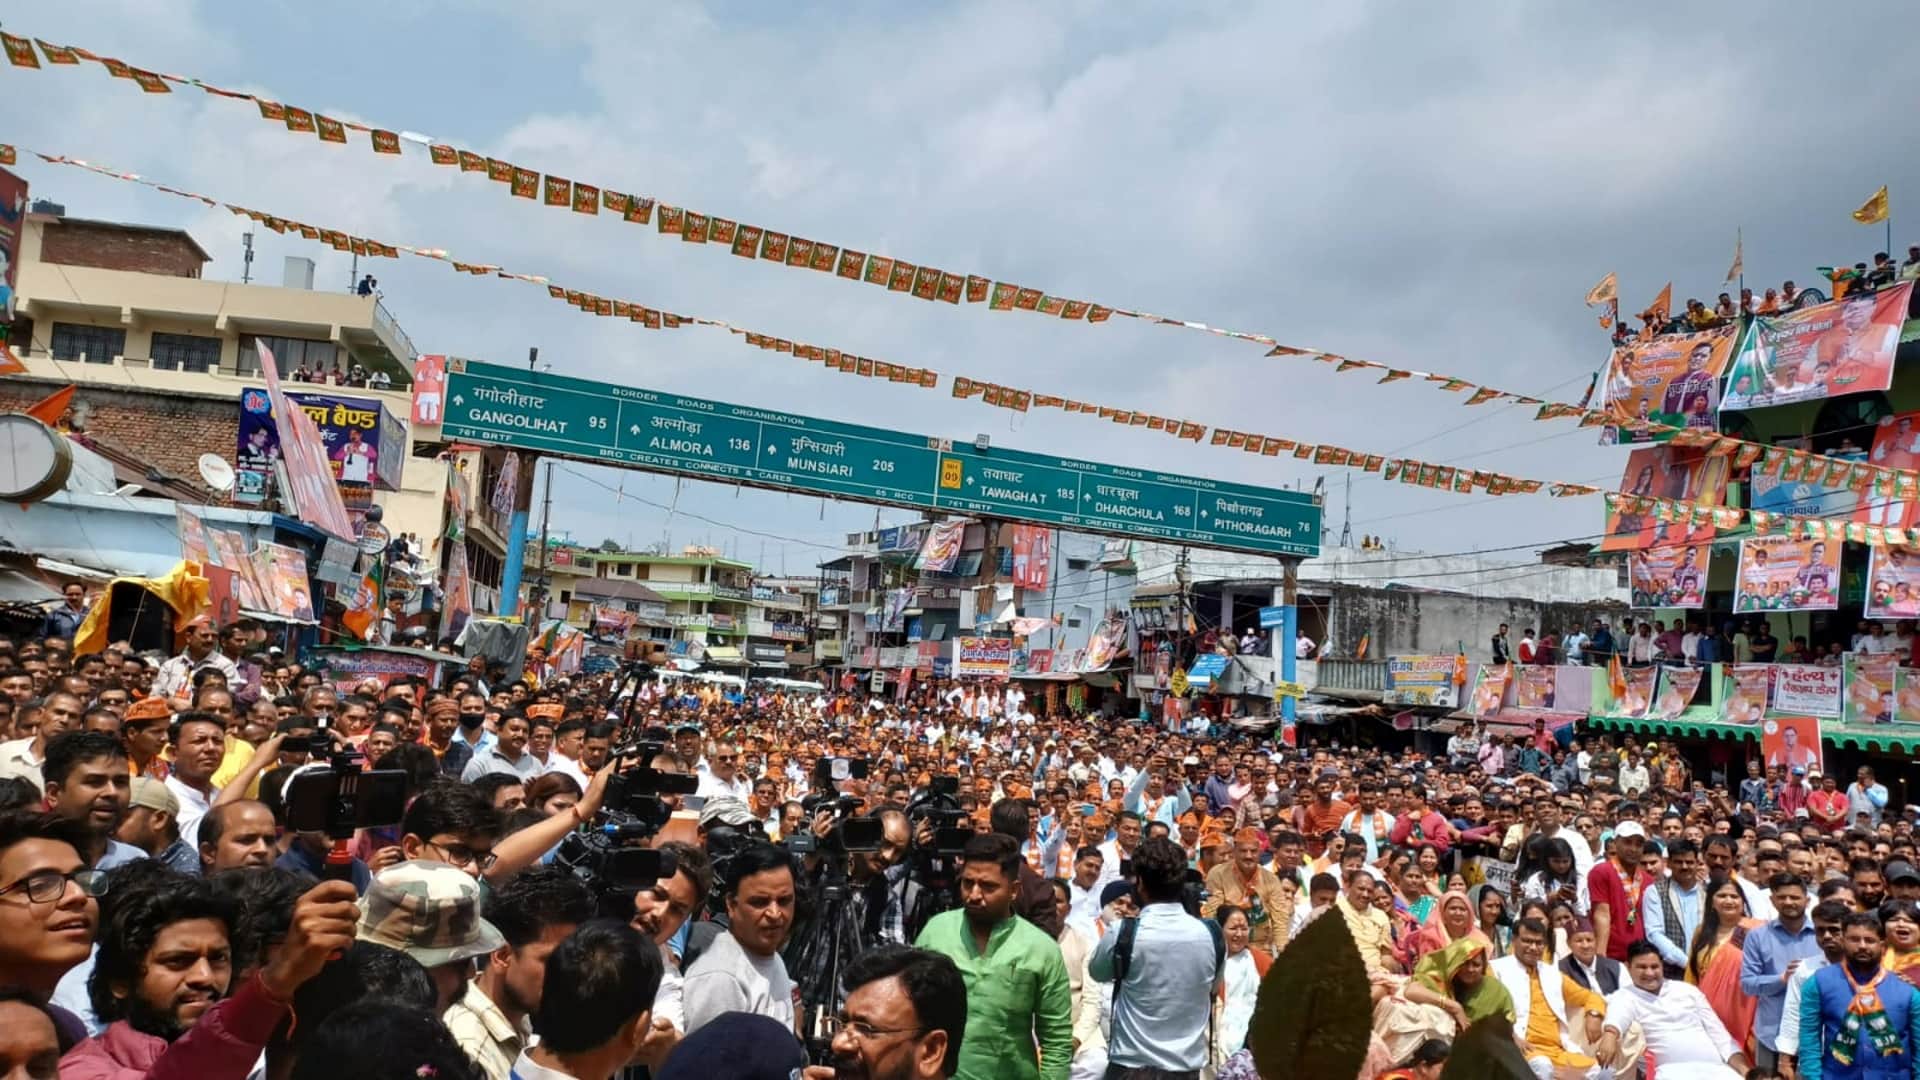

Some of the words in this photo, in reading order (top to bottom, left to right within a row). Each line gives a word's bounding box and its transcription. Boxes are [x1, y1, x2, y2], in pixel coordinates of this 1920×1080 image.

[472, 385, 548, 409] गंगोलीहाट
[612, 388, 658, 402] BORDER
[677, 398, 714, 410] ROADS
[732, 408, 805, 425] ORGANISATION
[334, 404, 378, 428] बैण्ड
[469, 408, 568, 434] GANGOLIHAT
[589, 416, 607, 429] 95
[650, 416, 703, 437] अल्मोड़ा
[458, 428, 476, 437] 761
[649, 436, 714, 456] ALMORA
[728, 438, 750, 451] 136
[790, 436, 845, 457] मुन्सियारी
[600, 449, 623, 459] BRO
[630, 453, 679, 467] CREATES
[685, 462, 739, 475] CONNECTS
[759, 472, 792, 483] CARES
[787, 457, 854, 477] MUNSIARI
[872, 459, 895, 473] 205
[1061, 460, 1097, 471] BORDER
[1112, 468, 1143, 478] ROADS
[1157, 475, 1216, 488] ORGANISATION
[981, 486, 1047, 504] TAWAGHAT
[1057, 488, 1075, 500] 185
[1095, 502, 1164, 521] DHARCHULA
[1173, 504, 1191, 517] 168
[1214, 518, 1291, 538] PITHORAGARH
[1297, 522, 1311, 533] 76
